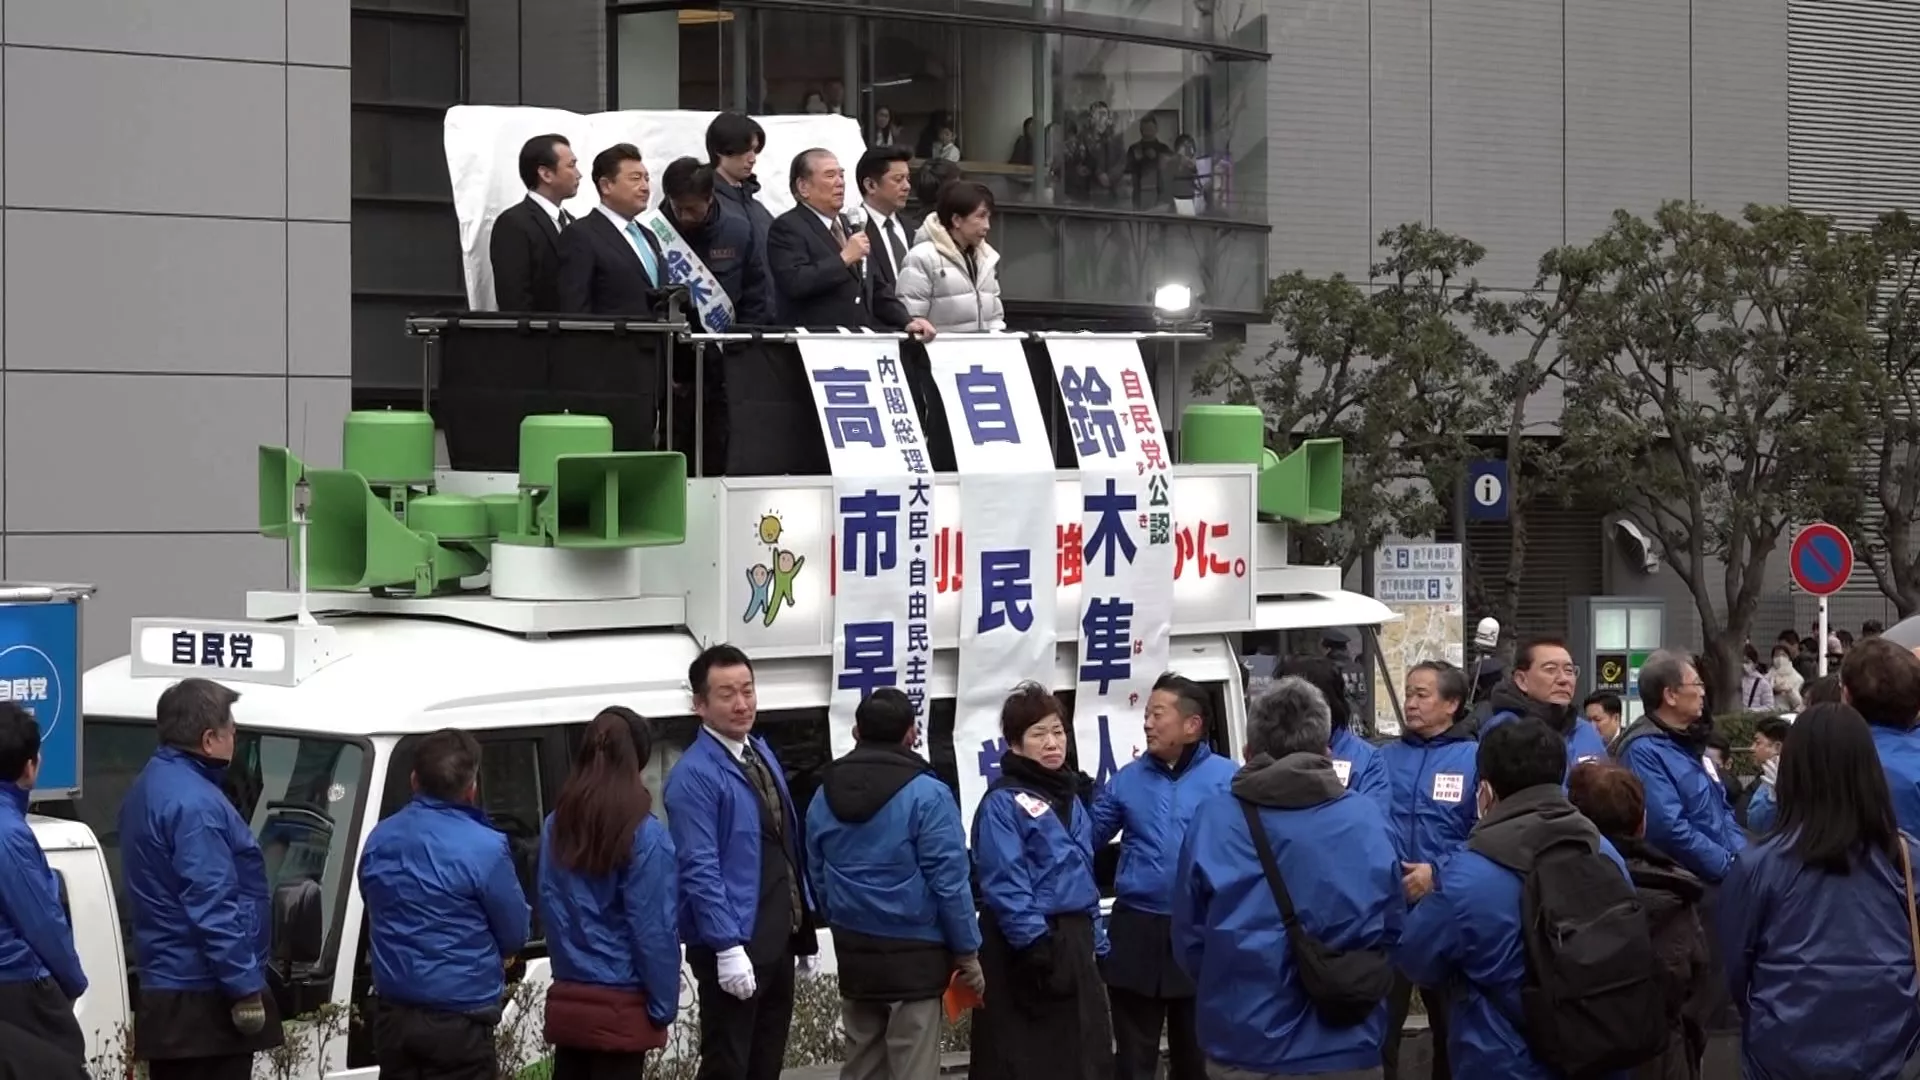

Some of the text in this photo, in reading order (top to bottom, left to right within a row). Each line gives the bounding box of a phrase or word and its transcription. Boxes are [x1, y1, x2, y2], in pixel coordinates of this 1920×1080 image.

[1119, 368, 1171, 545] 自民党公認
[172, 631, 254, 668] 自民党
[1060, 365, 1138, 790] 鈴木隼人
